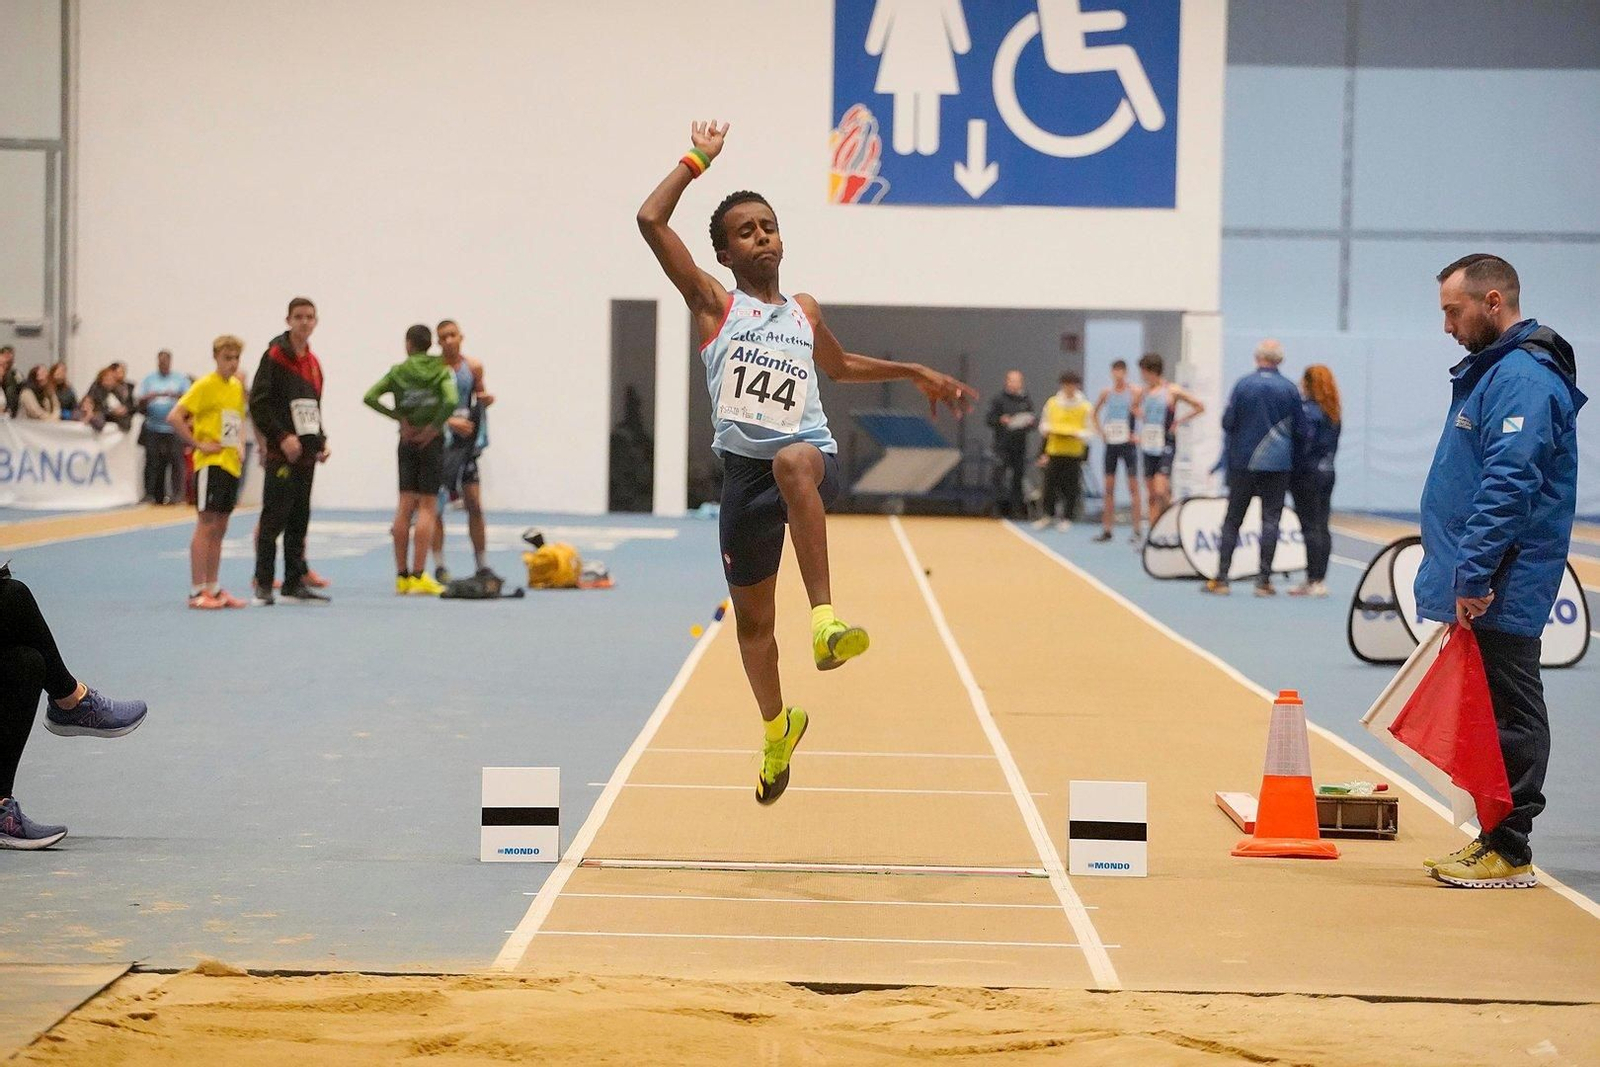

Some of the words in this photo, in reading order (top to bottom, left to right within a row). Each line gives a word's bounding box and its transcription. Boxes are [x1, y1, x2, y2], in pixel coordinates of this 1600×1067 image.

[731, 330, 762, 342] Celta
[730, 346, 808, 380] Atlántico
[733, 365, 796, 411] 144
[504, 847, 540, 855] MONDO
[1094, 862, 1130, 870] MONDO
